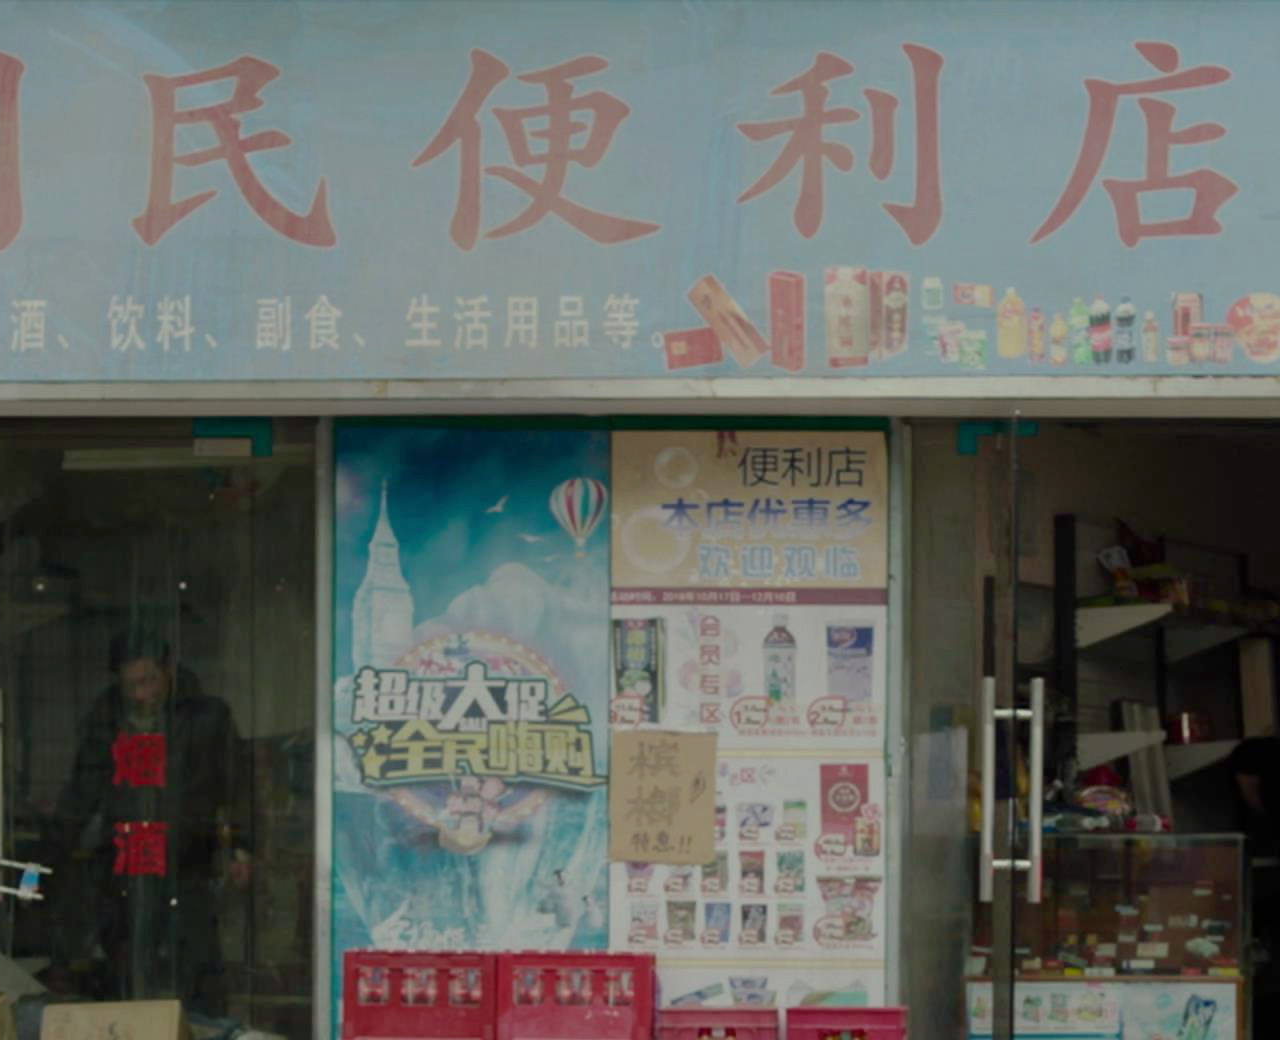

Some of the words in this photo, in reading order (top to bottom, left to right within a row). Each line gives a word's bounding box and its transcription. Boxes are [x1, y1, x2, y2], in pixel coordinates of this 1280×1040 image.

[737, 446, 868, 488] 便利店
[354, 661, 548, 732] 超级大促
